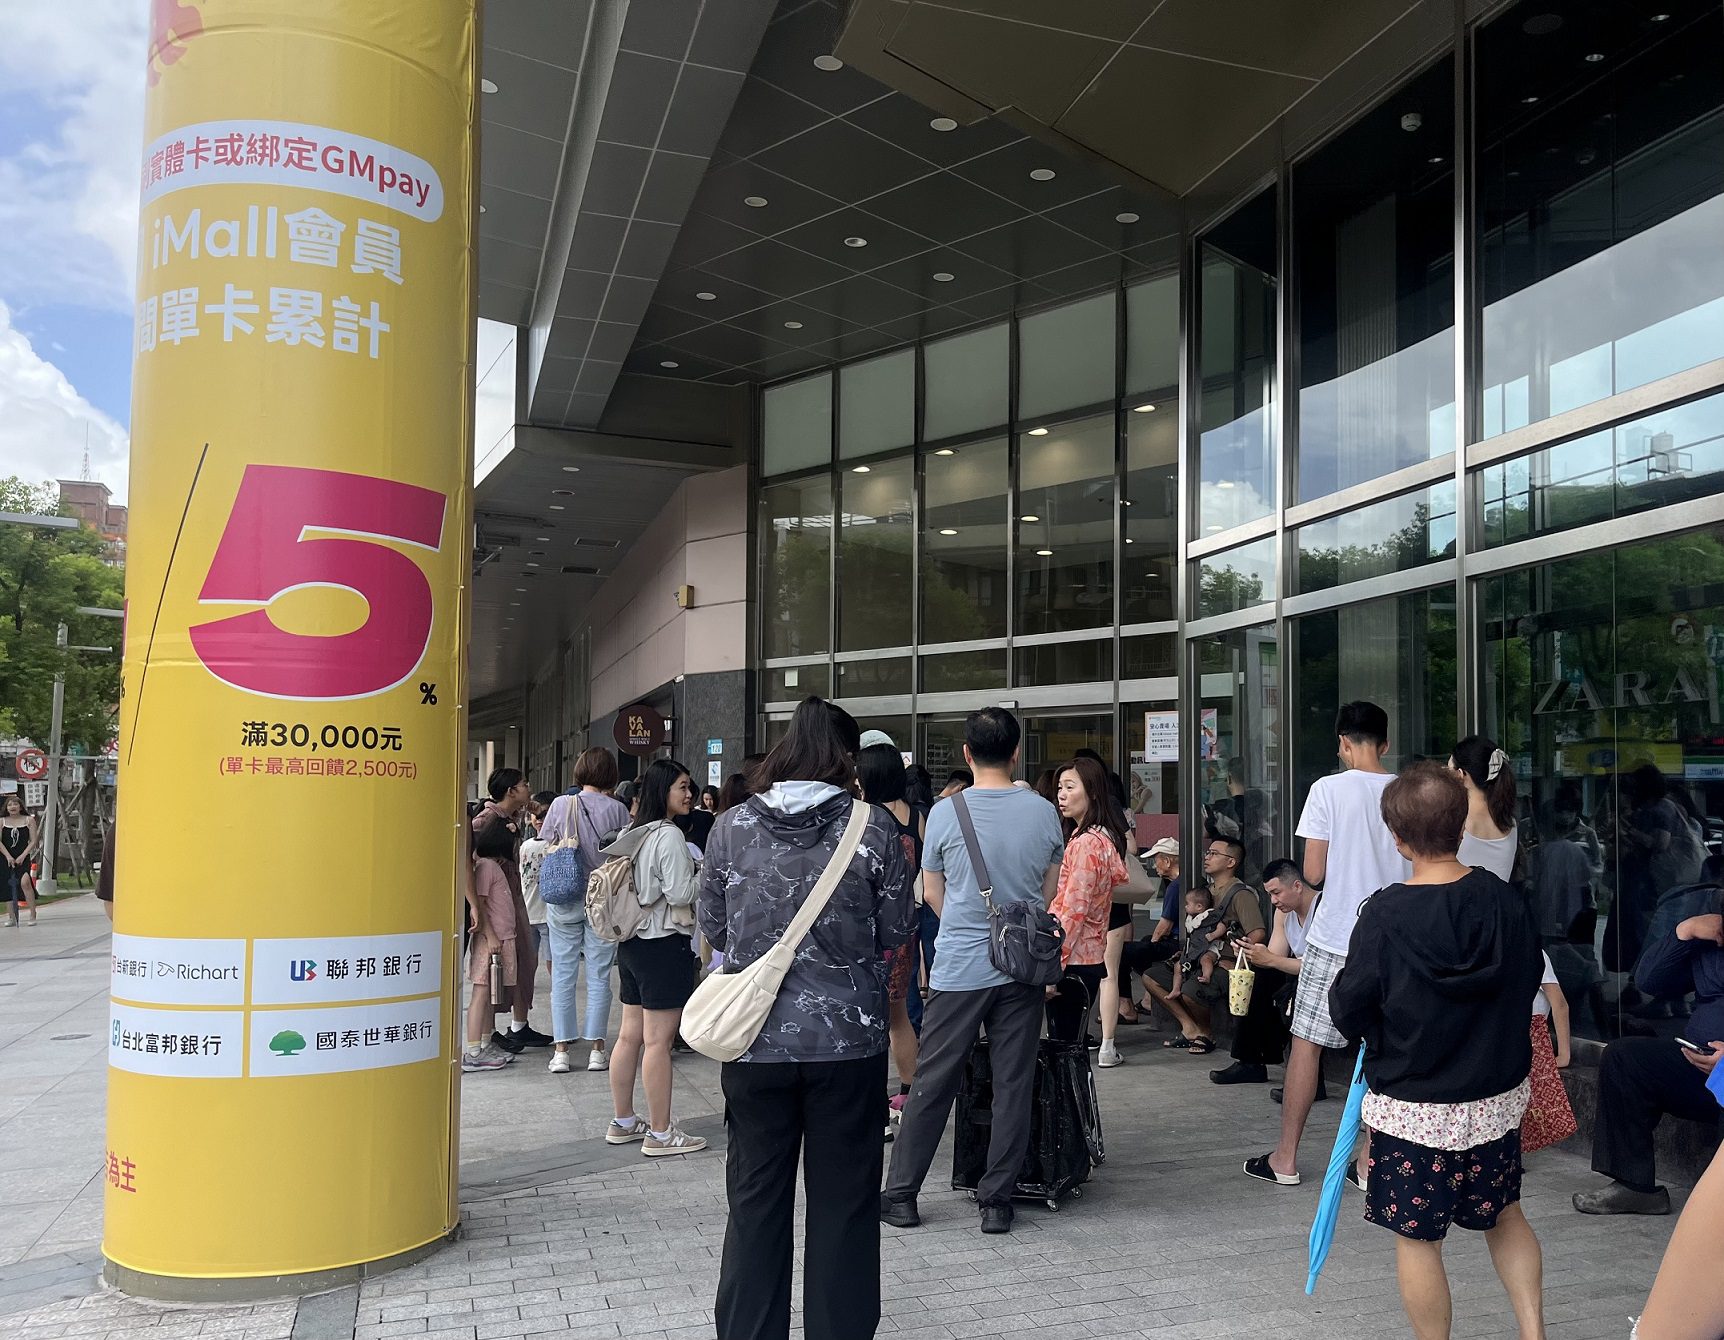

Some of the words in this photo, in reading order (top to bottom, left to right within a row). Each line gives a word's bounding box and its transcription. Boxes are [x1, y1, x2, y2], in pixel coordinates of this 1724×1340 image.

[1533, 666, 1708, 715] ZARA
[241, 721, 402, 752] 滿30,000元
[219, 757, 418, 779] (單卡最高回饋2,500元)
[177, 963, 239, 981] Richart
[326, 953, 422, 980] 聯邦銀行
[122, 1029, 221, 1056] 台北富邦銀行
[316, 1020, 433, 1051] 國泰世華銀行
[106, 1150, 137, 1193] 為主
